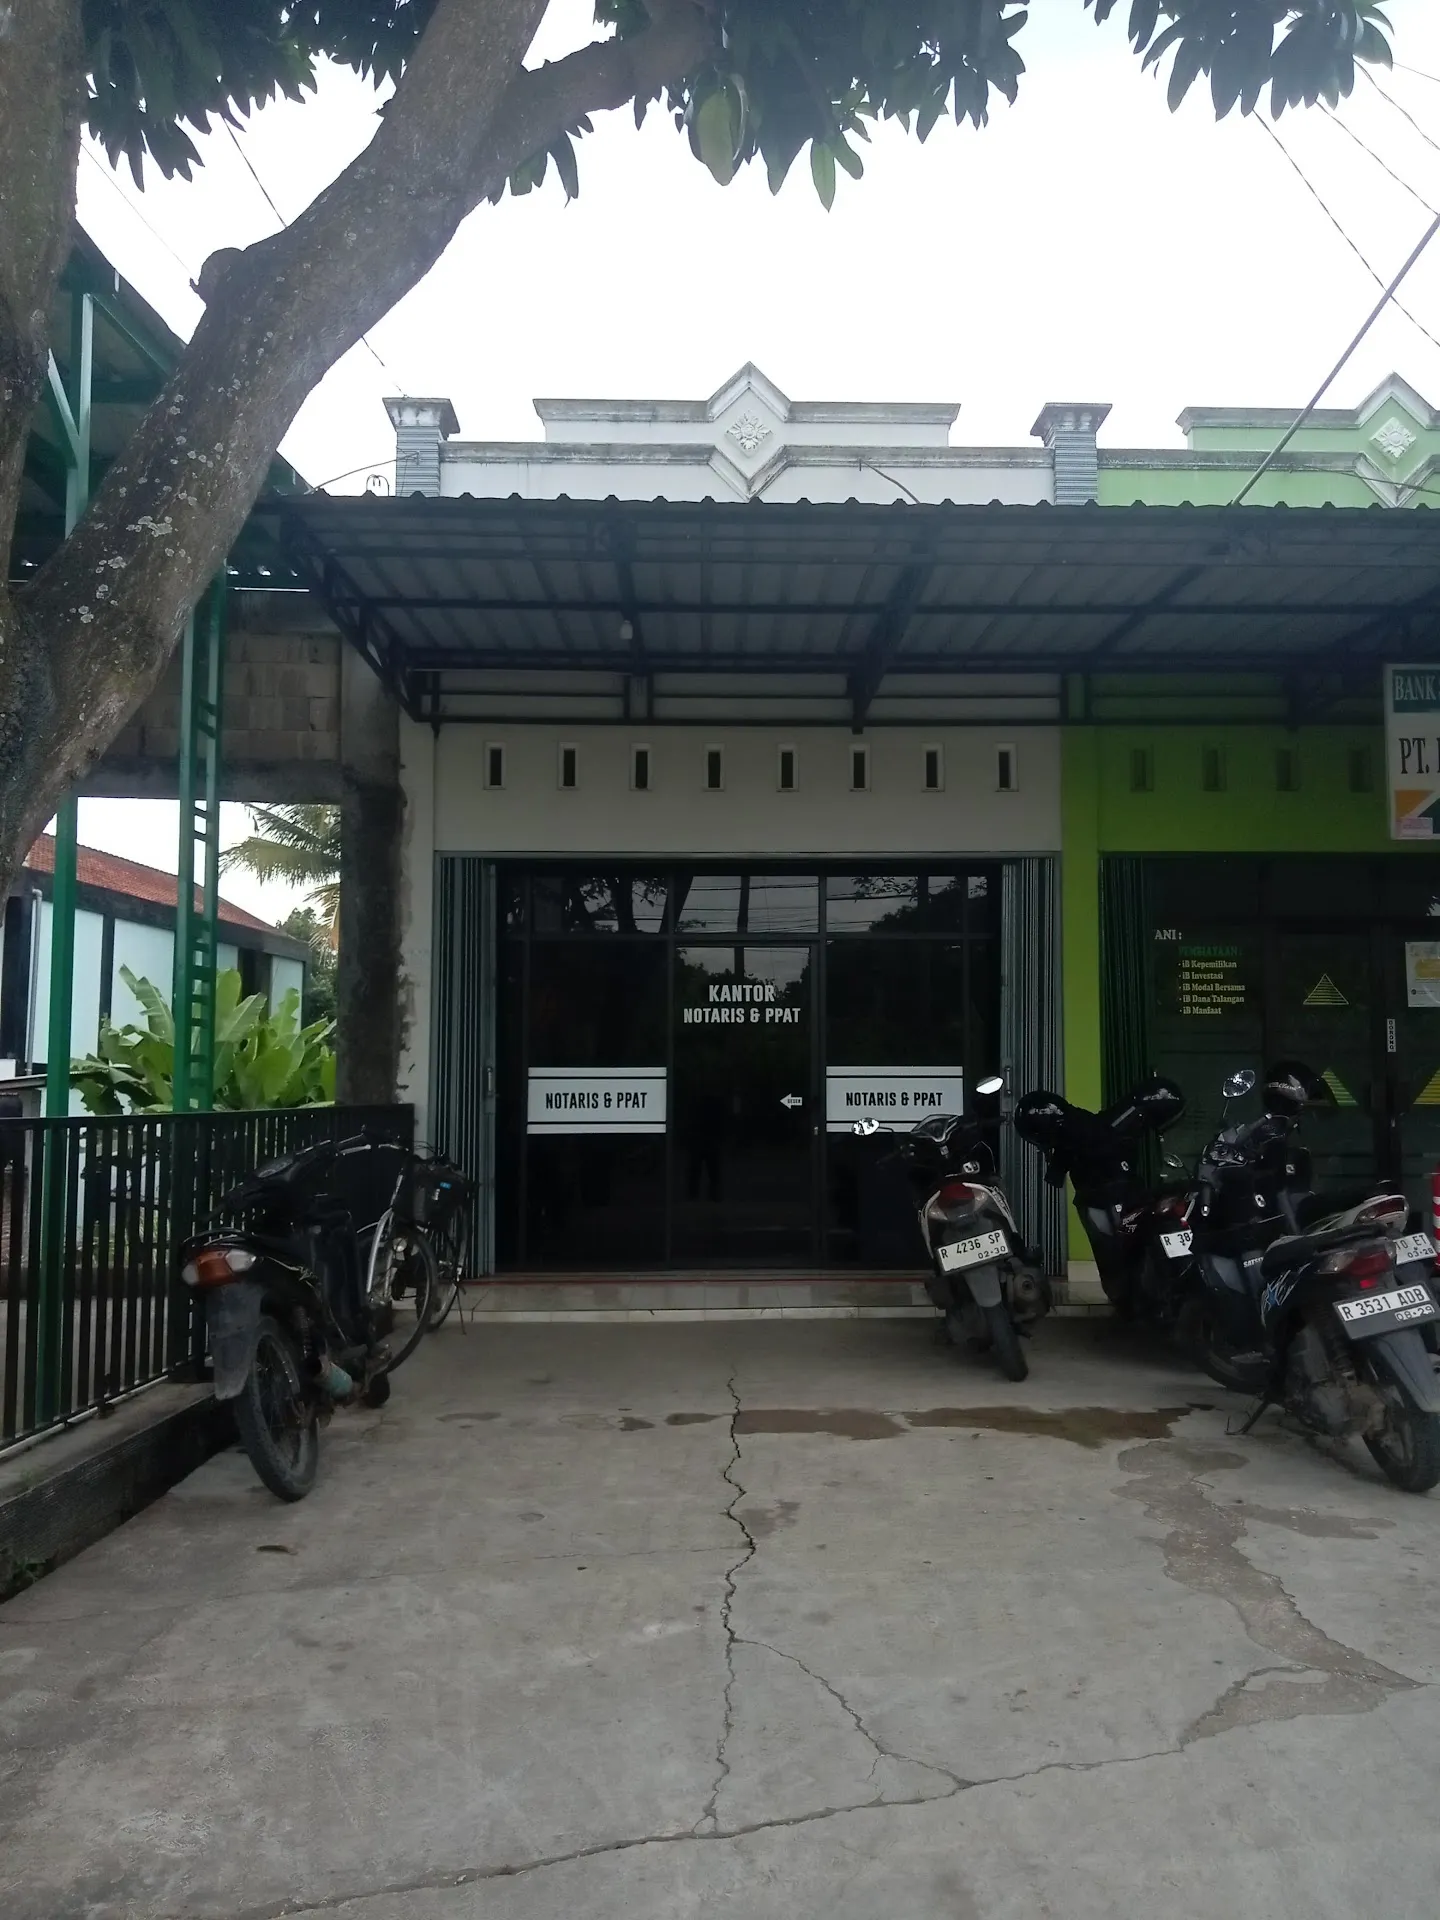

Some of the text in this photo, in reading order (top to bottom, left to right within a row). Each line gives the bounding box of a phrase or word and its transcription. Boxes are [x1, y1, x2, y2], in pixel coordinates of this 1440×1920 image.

[1394, 675, 1437, 701] BANK
[1398, 737, 1430, 774] PT.
[1191, 959, 1237, 970] Kepemilikan
[1191, 971, 1224, 980] Investasi
[708, 984, 776, 1002] KANTOR
[1191, 983, 1214, 991] Modal
[1214, 983, 1246, 991] Bersama
[1192, 995, 1210, 1003] Dana
[1211, 994, 1245, 1004] Talangan
[683, 1007, 801, 1024] NOTARIS & PPAT
[1192, 1006, 1222, 1015] Manfaat
[545, 1092, 648, 1109] NOTARIS & PPAT
[845, 1092, 944, 1107] NOTARIS & PPAT
[940, 1232, 1001, 1260] R 4236 SP
[1163, 1236, 1172, 1246] R
[1412, 1234, 1427, 1246] ET
[1342, 1288, 1425, 1320] R 3531 ADB
